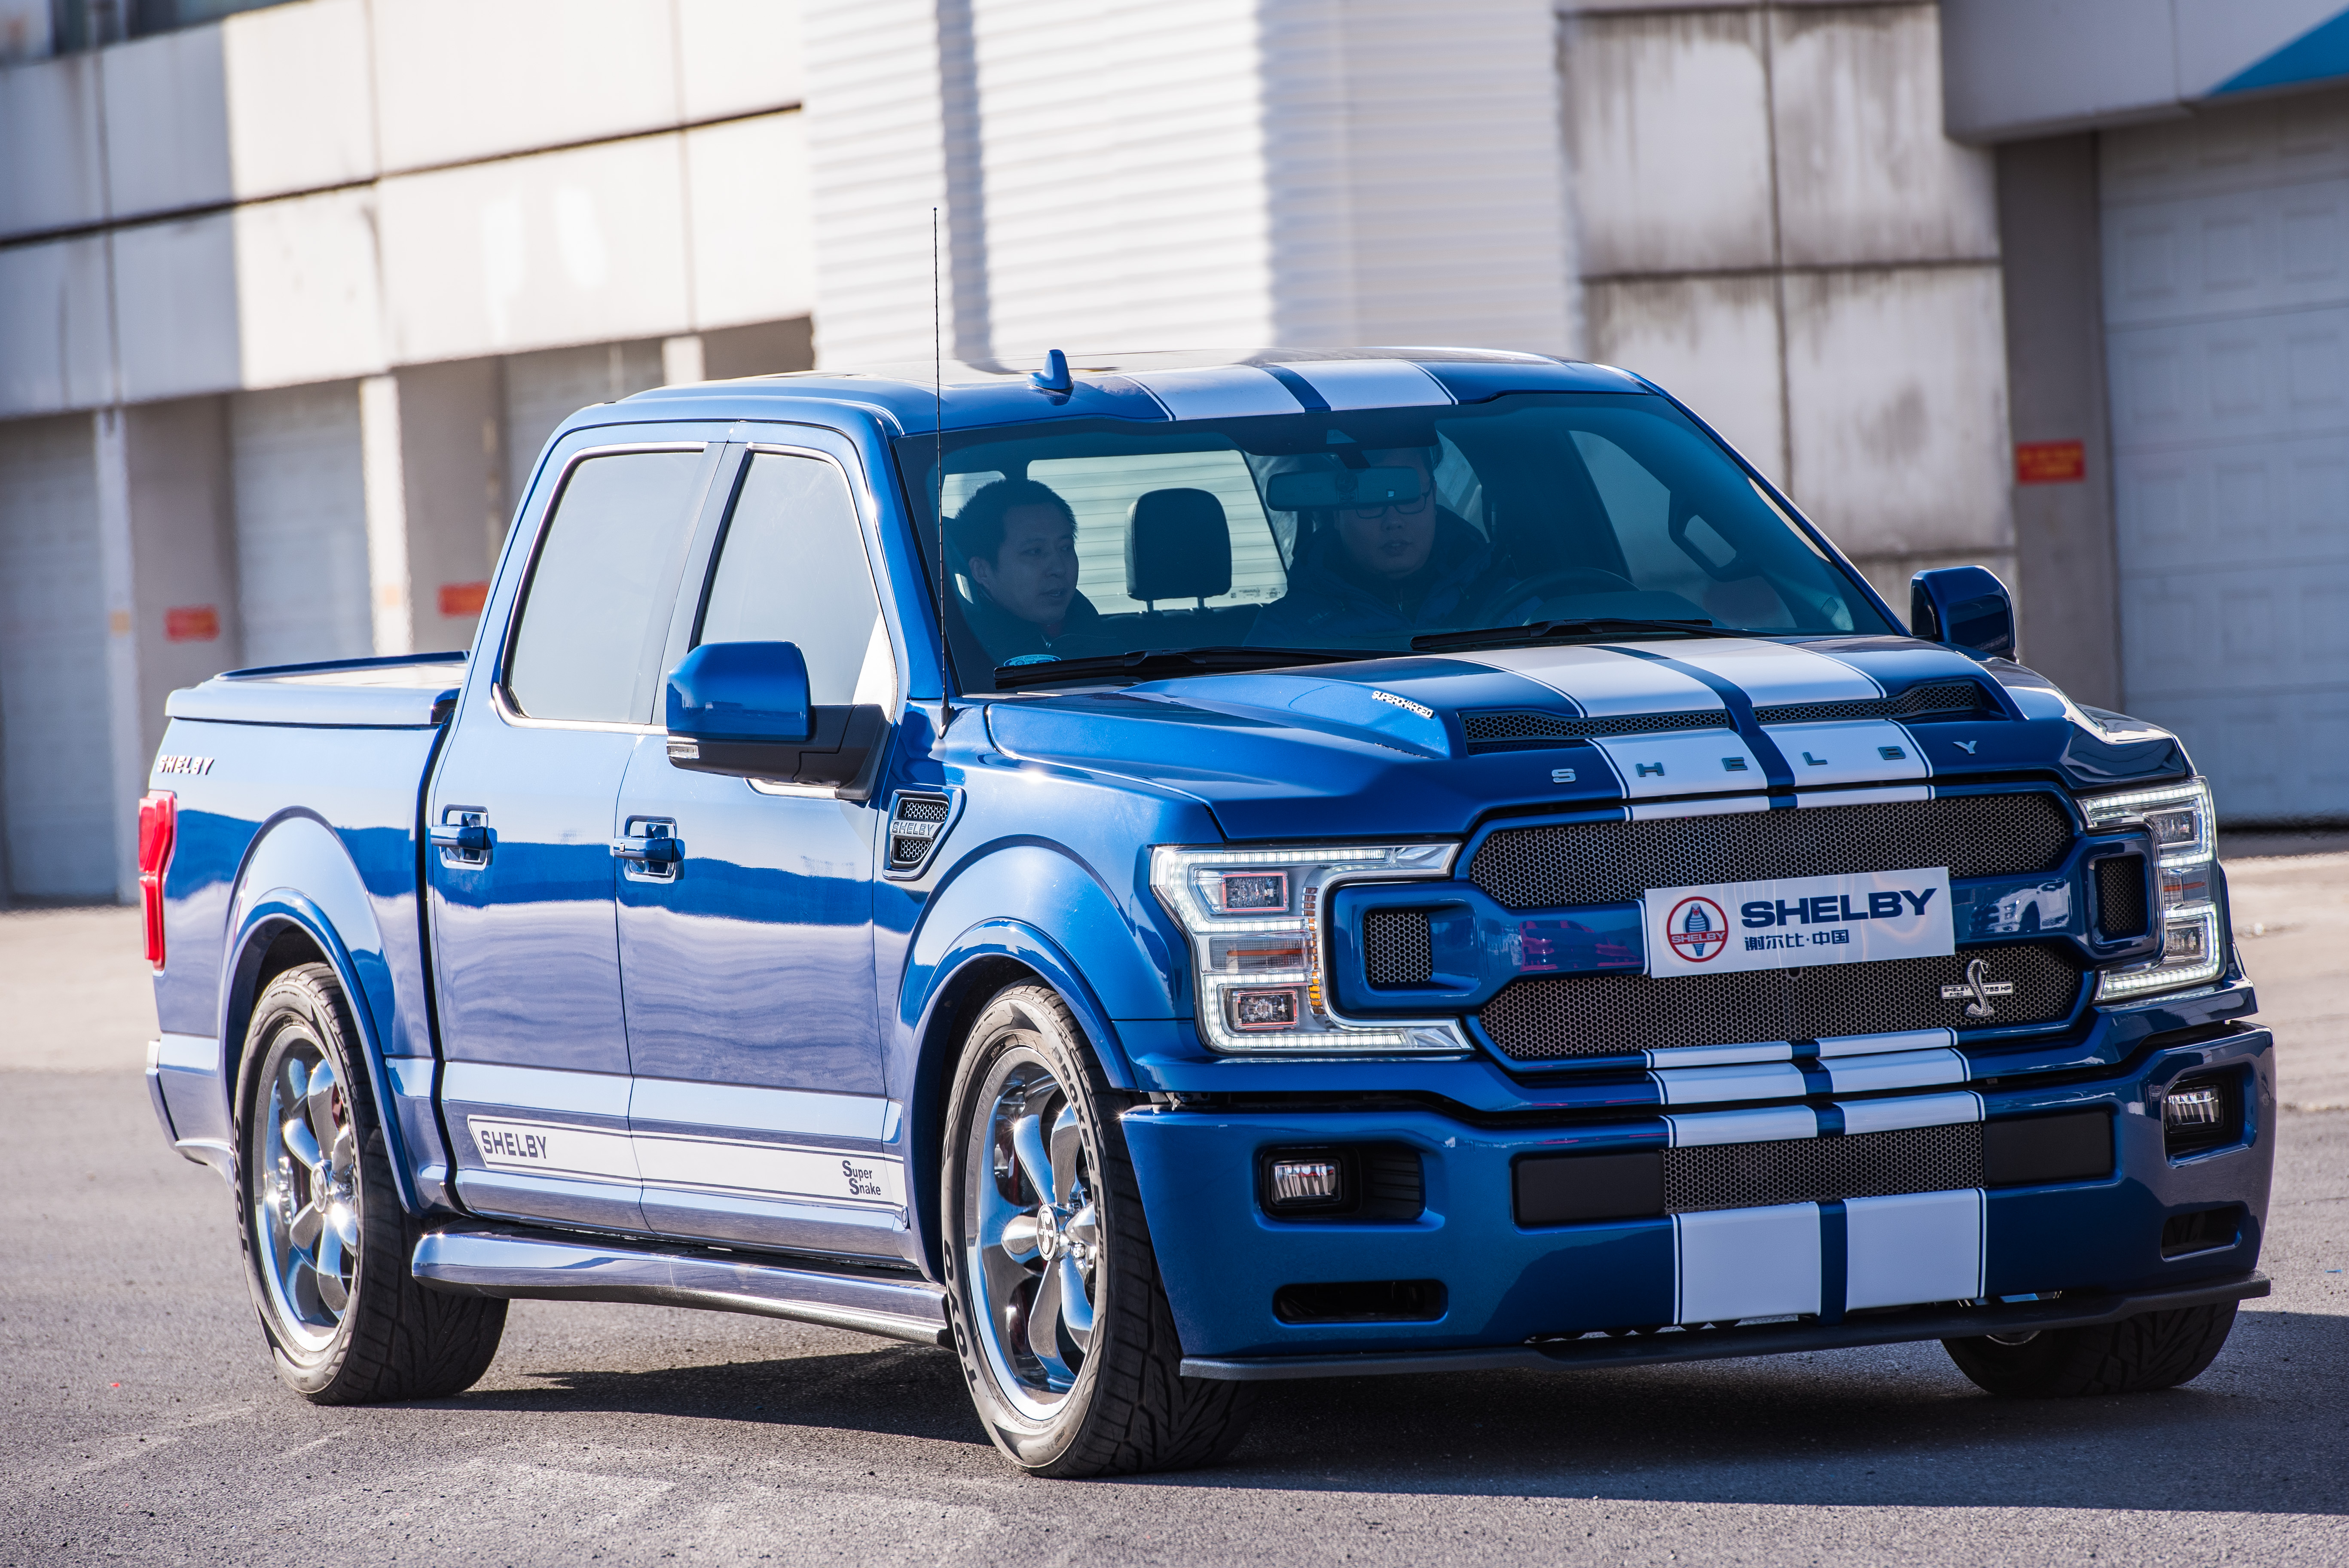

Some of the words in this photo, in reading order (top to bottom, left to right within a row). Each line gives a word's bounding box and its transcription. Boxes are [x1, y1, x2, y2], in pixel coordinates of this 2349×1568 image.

[1372, 691, 1435, 719] SUPERCHARGED
[156, 755, 214, 775] SHELBY
[1552, 741, 1977, 783] SHELBY
[892, 821, 935, 836] SHELBY
[1741, 888, 1938, 928] SHELBY
[1671, 932, 1726, 943] SHELBY
[1052, 1046, 1095, 1171] PROXES
[481, 1130, 547, 1159] SHELBY
[842, 1160, 872, 1181] Super
[234, 1116, 249, 1260] TOYO
[849, 1178, 881, 1196] Snake
[944, 1239, 977, 1393] TOYO
